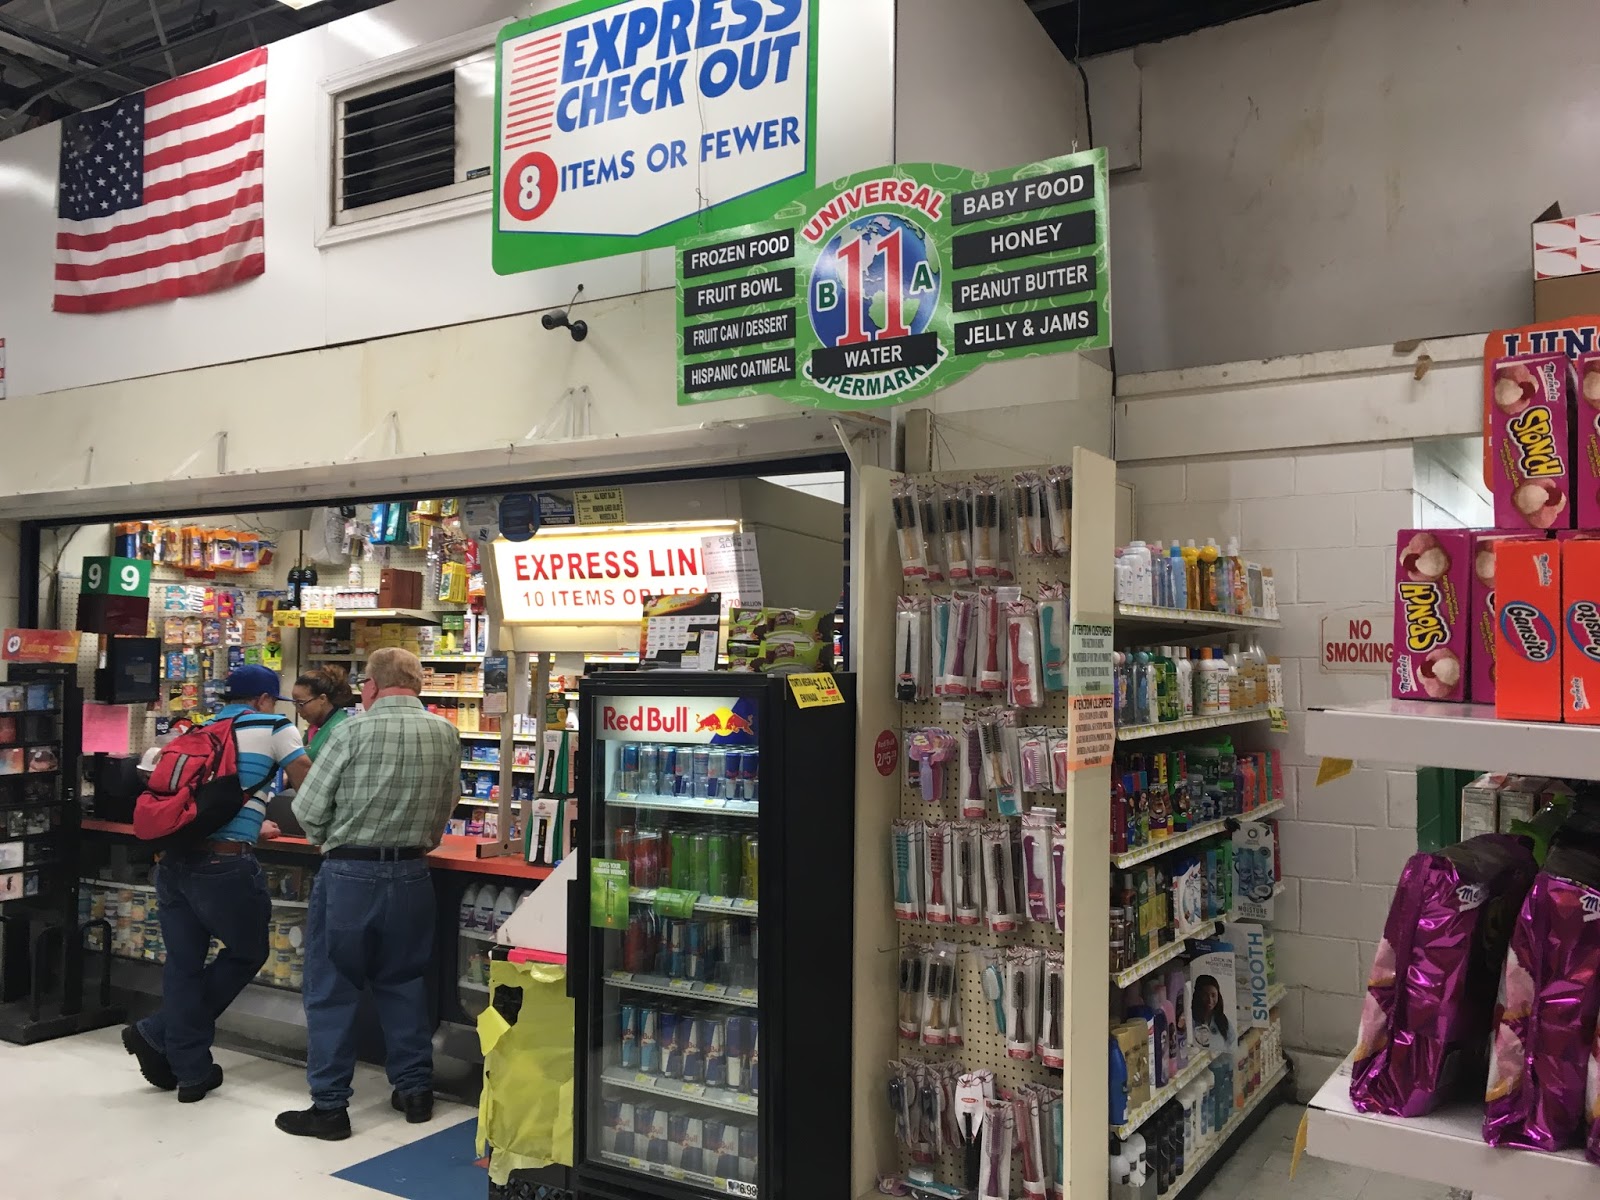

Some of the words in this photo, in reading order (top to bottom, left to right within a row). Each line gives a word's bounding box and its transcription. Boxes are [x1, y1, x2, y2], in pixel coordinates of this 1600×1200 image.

[561, 0, 801, 85] EXPRESS
[556, 58, 689, 132] CHECK
[699, 31, 801, 98] OUT
[518, 164, 541, 212] 8
[561, 150, 635, 192] ITEMS
[646, 139, 688, 173] OR
[701, 116, 801, 163] FEWER
[804, 180, 943, 242] UNIVERSAL
[963, 187, 1018, 215] BABY
[691, 243, 746, 270] FROZEN
[749, 235, 790, 258] FOOD
[991, 222, 1063, 253] HONEY
[698, 284, 737, 306] FRUIT
[740, 276, 782, 298] BOWL
[818, 282, 836, 308] B
[837, 228, 908, 346] 11
[913, 263, 933, 292] A
[961, 276, 1022, 303] PEANUT
[1025, 265, 1088, 292] BUTTER
[693, 327, 719, 346] FRUIT
[720, 323, 740, 342] CAN
[746, 315, 788, 337] DESSERT
[964, 320, 1017, 346] JELLY
[1022, 318, 1035, 337] &
[1040, 310, 1090, 334] JAMS
[1504, 328, 1600, 359] LUN
[692, 364, 738, 385] HISPANIC
[740, 356, 791, 378] OATMEAL
[845, 345, 902, 368] WATER
[1543, 361, 1559, 401] Marinela
[1510, 406, 1564, 477] SPONCH
[88, 563, 103, 590] 9
[120, 565, 141, 591] 9
[514, 550, 639, 581] EXPRESS
[649, 548, 706, 577] LIN
[523, 591, 545, 607] 10
[552, 589, 615, 607] ITEMS
[1349, 620, 1372, 640] NO
[1400, 583, 1450, 651] SPONCH
[1506, 604, 1547, 661] Gansito
[1326, 642, 1393, 663] SMOKING
[813, 676, 835, 692] $1.19
[603, 706, 643, 731] Red
[647, 706, 688, 732] Bull
[1248, 933, 1268, 1021] SMOOTH
[740, 1183, 757, 1197] 6.99
